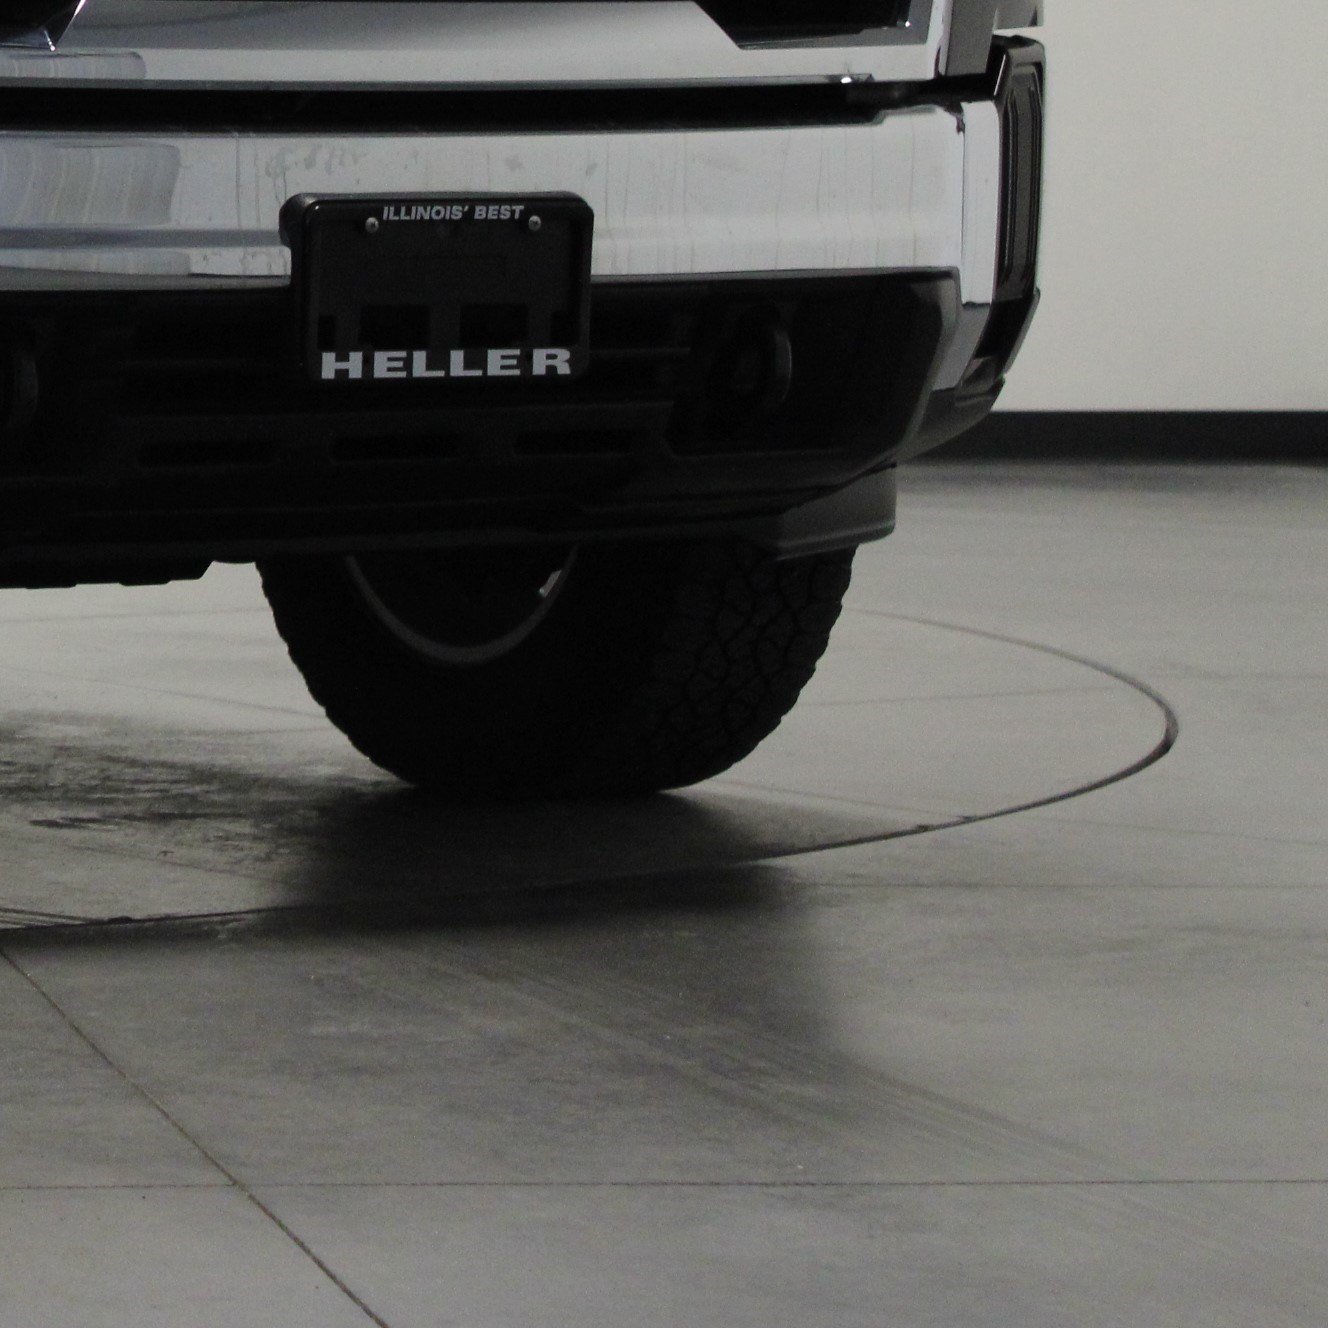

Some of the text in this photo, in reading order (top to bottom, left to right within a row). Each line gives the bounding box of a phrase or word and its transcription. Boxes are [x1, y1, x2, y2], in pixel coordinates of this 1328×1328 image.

[382, 204, 524, 221] ILLINOIS' BEST
[320, 348, 572, 380] HELLER
